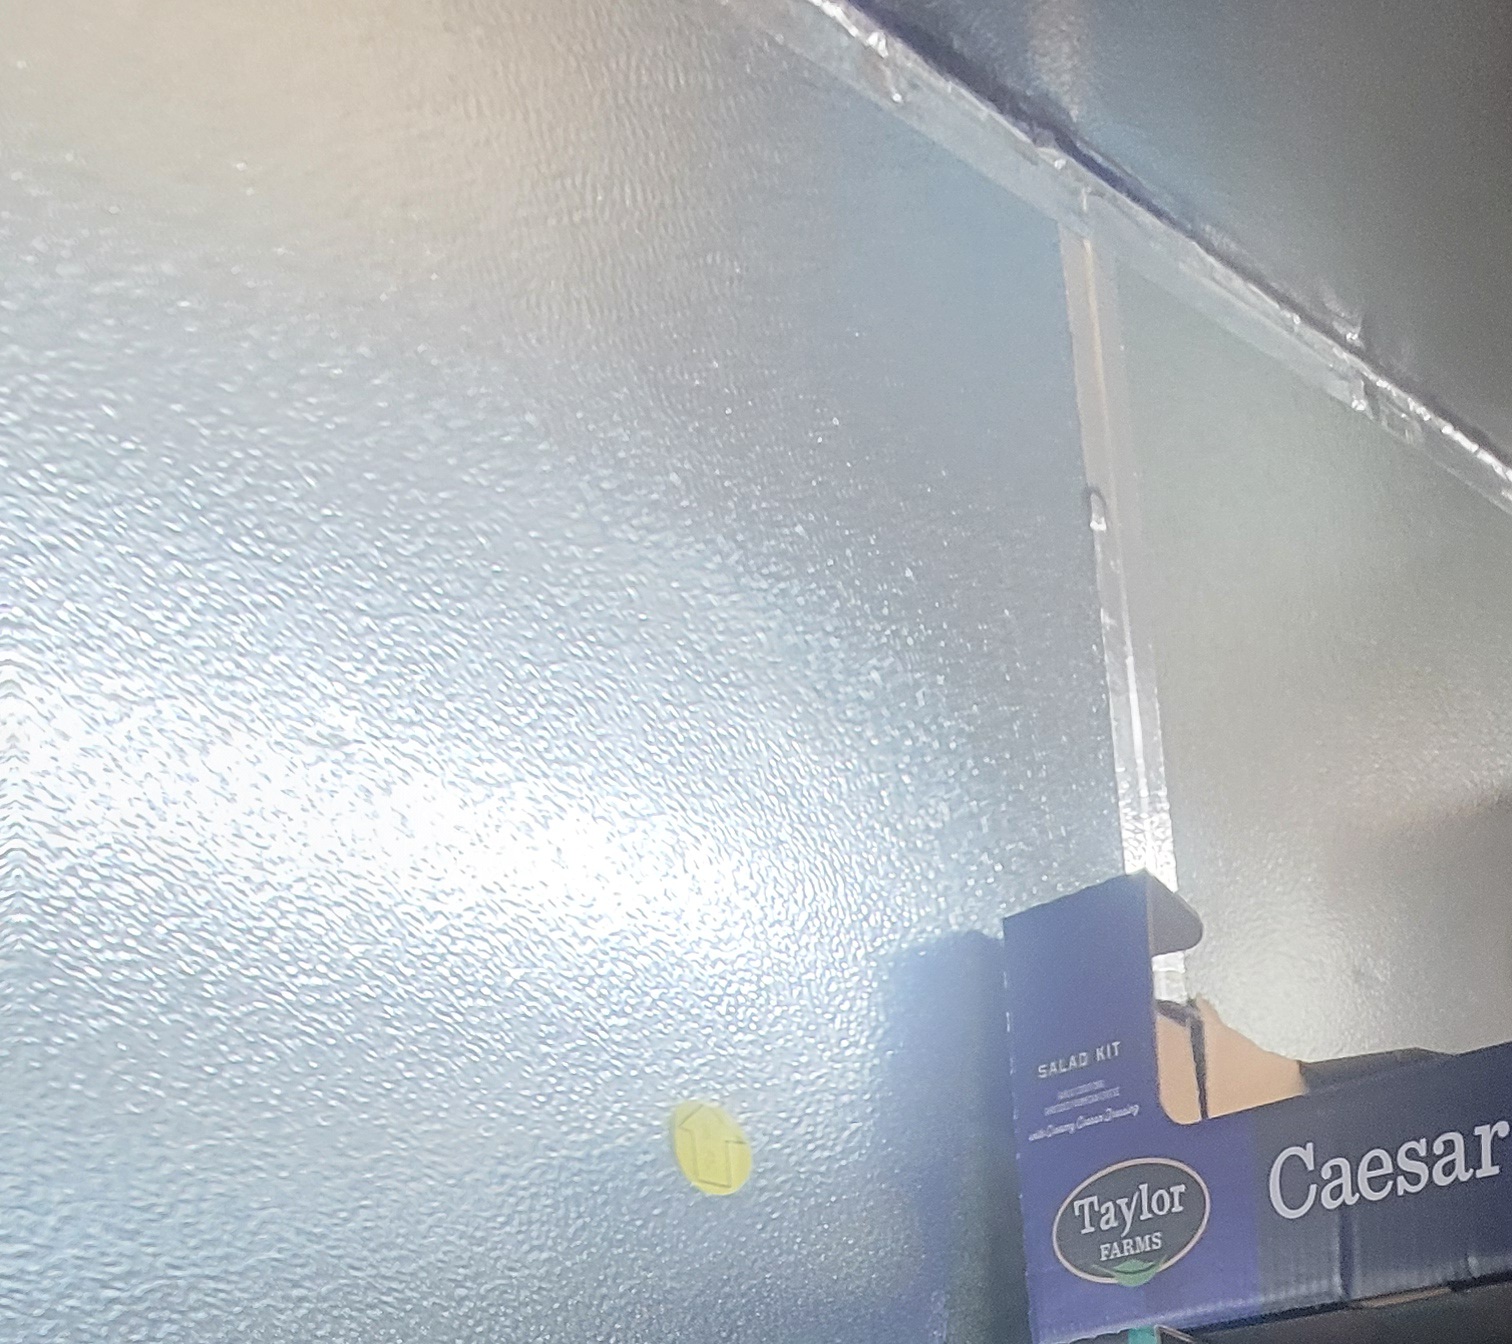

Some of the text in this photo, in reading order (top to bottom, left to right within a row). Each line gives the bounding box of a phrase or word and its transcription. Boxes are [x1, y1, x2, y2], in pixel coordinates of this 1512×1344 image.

[1038, 1041, 1121, 1078] SALAD KIT
[1268, 1119, 1510, 1220] Caesar
[1073, 1183, 1187, 1238] Taylor
[1100, 1231, 1163, 1261] FARMS
